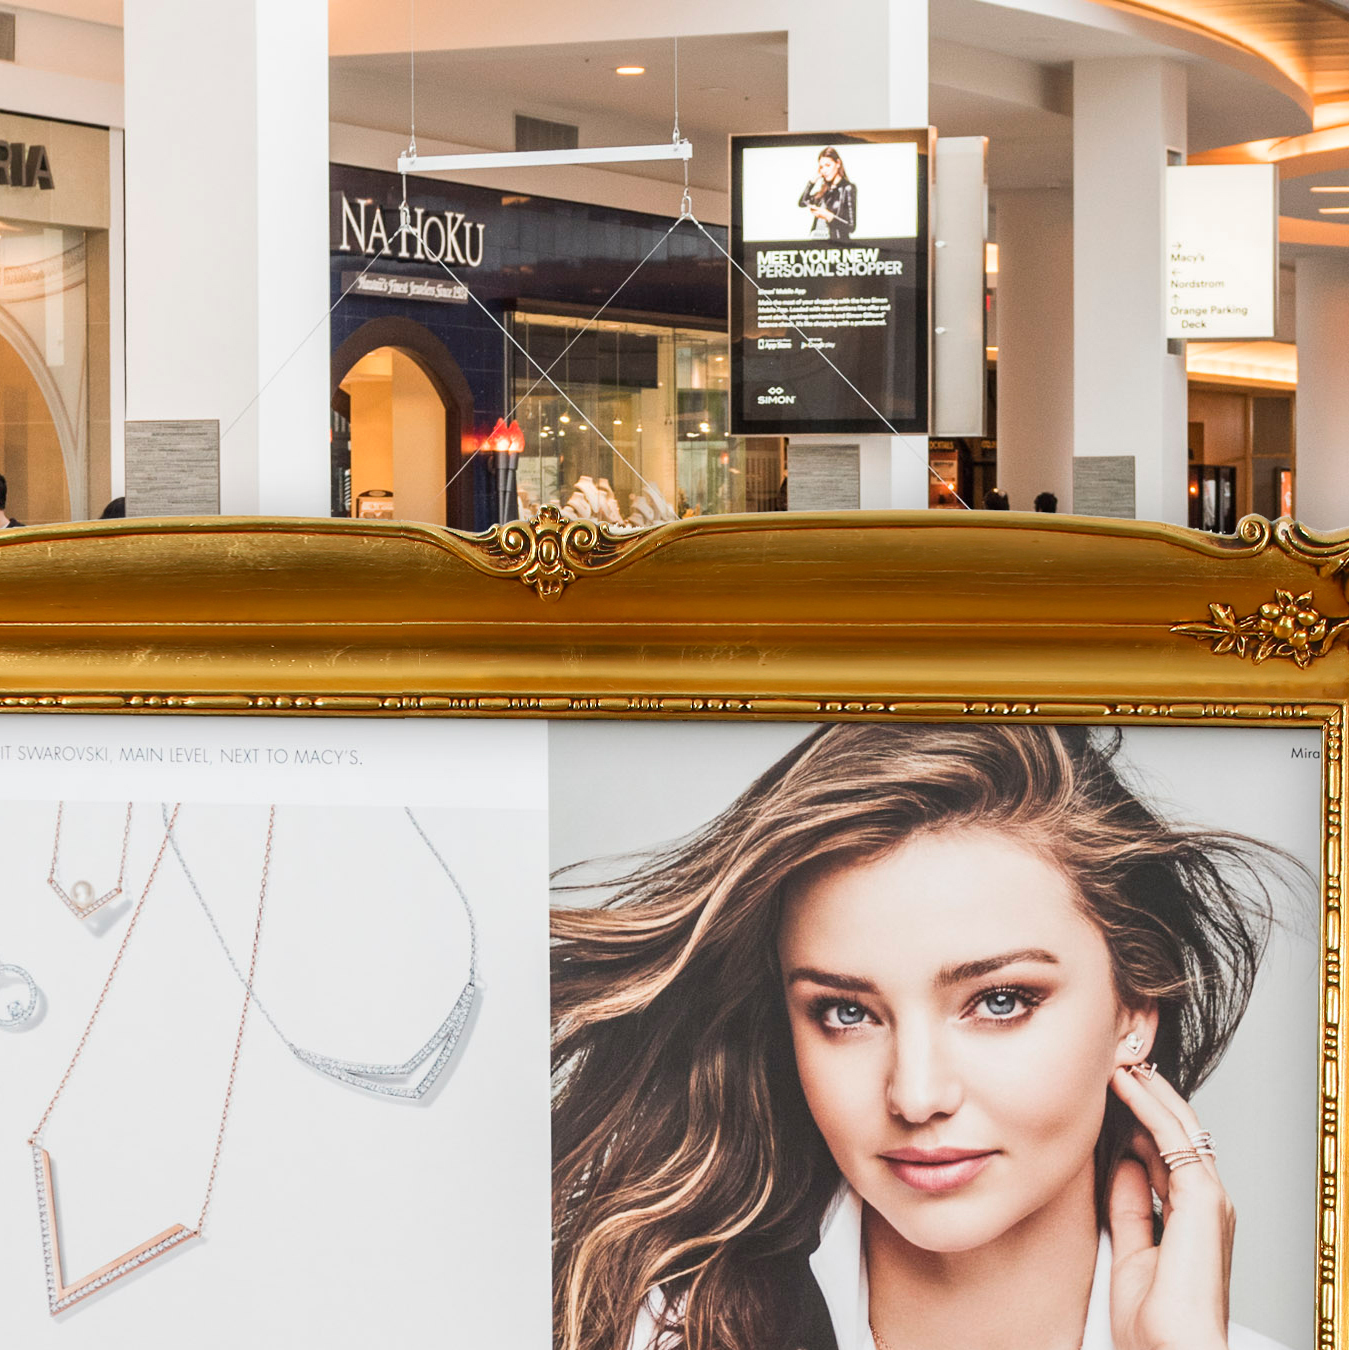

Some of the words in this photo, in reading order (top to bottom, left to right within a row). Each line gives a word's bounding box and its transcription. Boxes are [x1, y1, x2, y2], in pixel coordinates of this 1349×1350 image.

[339, 190, 392, 254] NA
[398, 205, 485, 267] HOKU
[757, 250, 798, 264] MEET
[799, 249, 840, 264] YOUR
[842, 248, 879, 263] NEW
[1171, 253, 1205, 263] Macy's
[757, 263, 834, 278] PERSONAL
[836, 261, 902, 277] SHOPPER
[1171, 280, 1224, 288] Nordstrom
[1170, 306, 1207, 316] Orange
[1210, 305, 1248, 316] Parking
[1181, 320, 1206, 328] Deck
[757, 395, 795, 404] SIMON
[18, 745, 113, 763] SWAROVSKI,
[119, 748, 163, 762] MAIN
[169, 747, 213, 765] LEVEL,
[220, 748, 260, 764] NEXT
[266, 748, 288, 764] TO
[294, 749, 363, 765] MACY'S.
[1291, 747, 1320, 759] Mira
